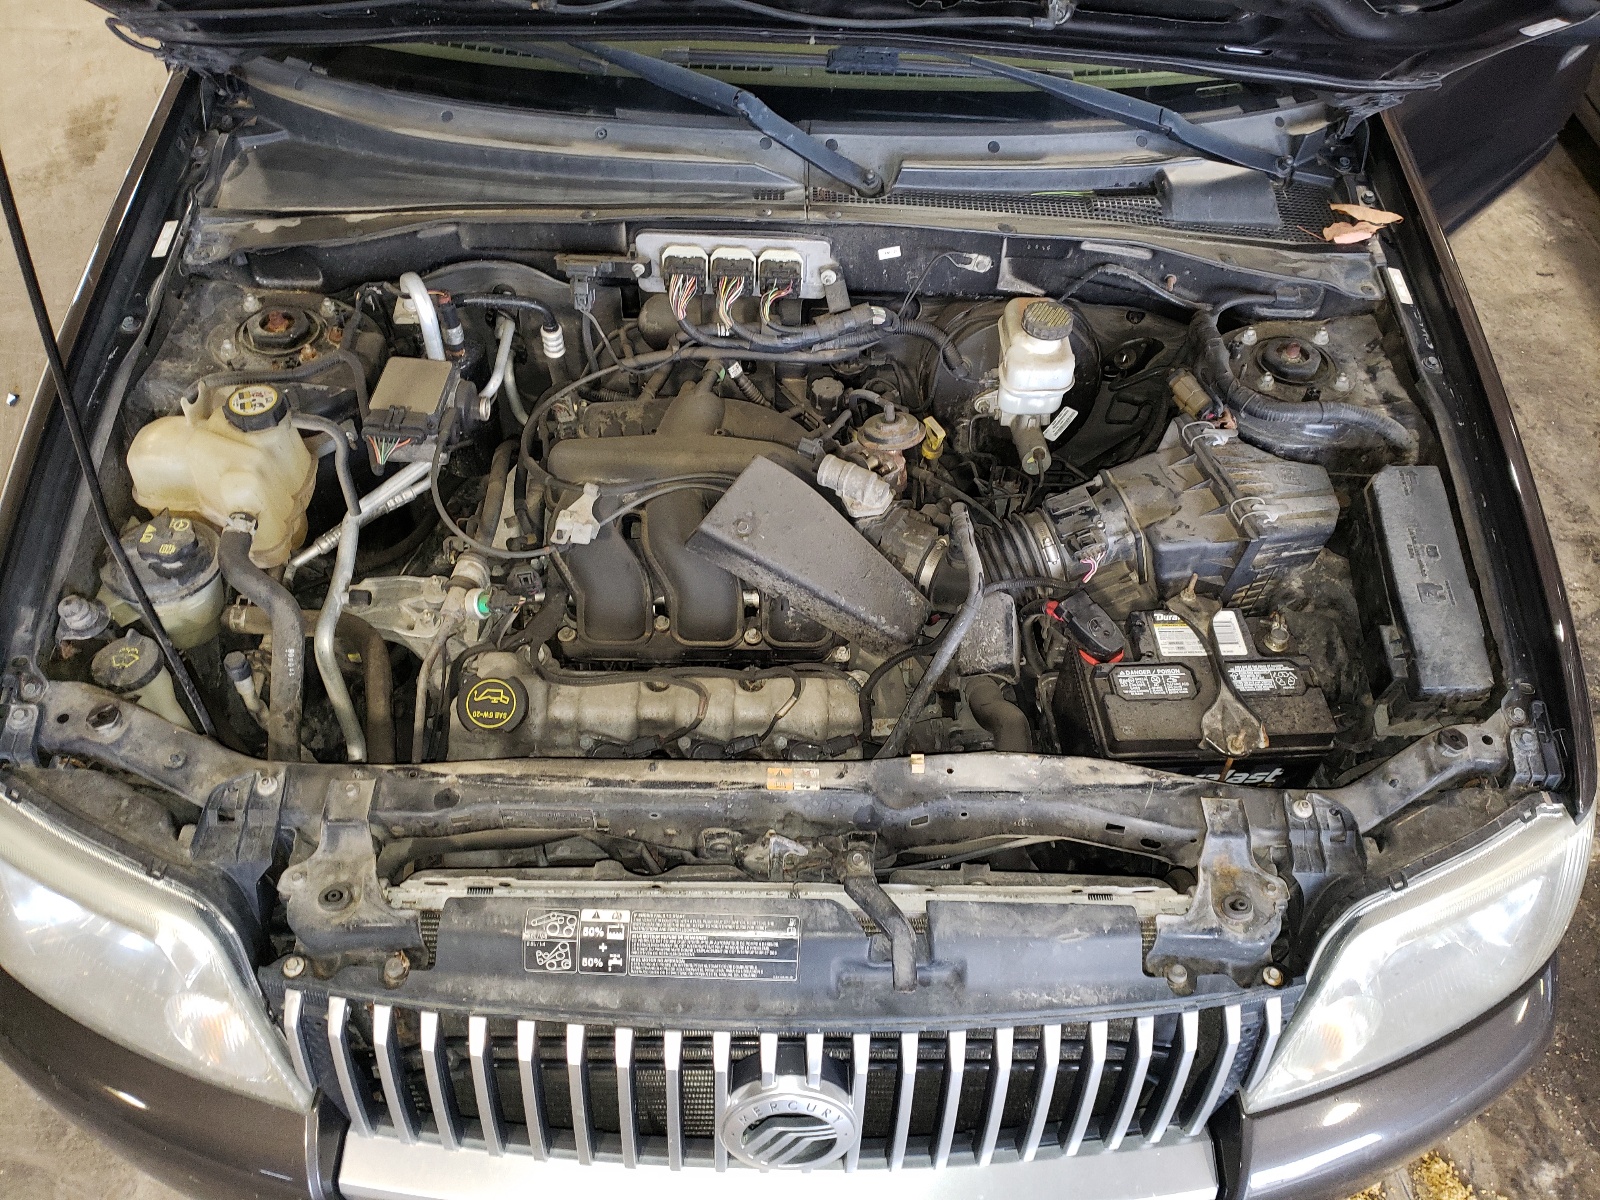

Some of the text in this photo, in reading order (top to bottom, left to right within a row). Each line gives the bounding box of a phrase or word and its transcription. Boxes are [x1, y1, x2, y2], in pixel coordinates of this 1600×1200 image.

[1153, 613, 1181, 621] Dura
[1195, 767, 1284, 783] alast
[739, 1101, 843, 1126] MERCURY
